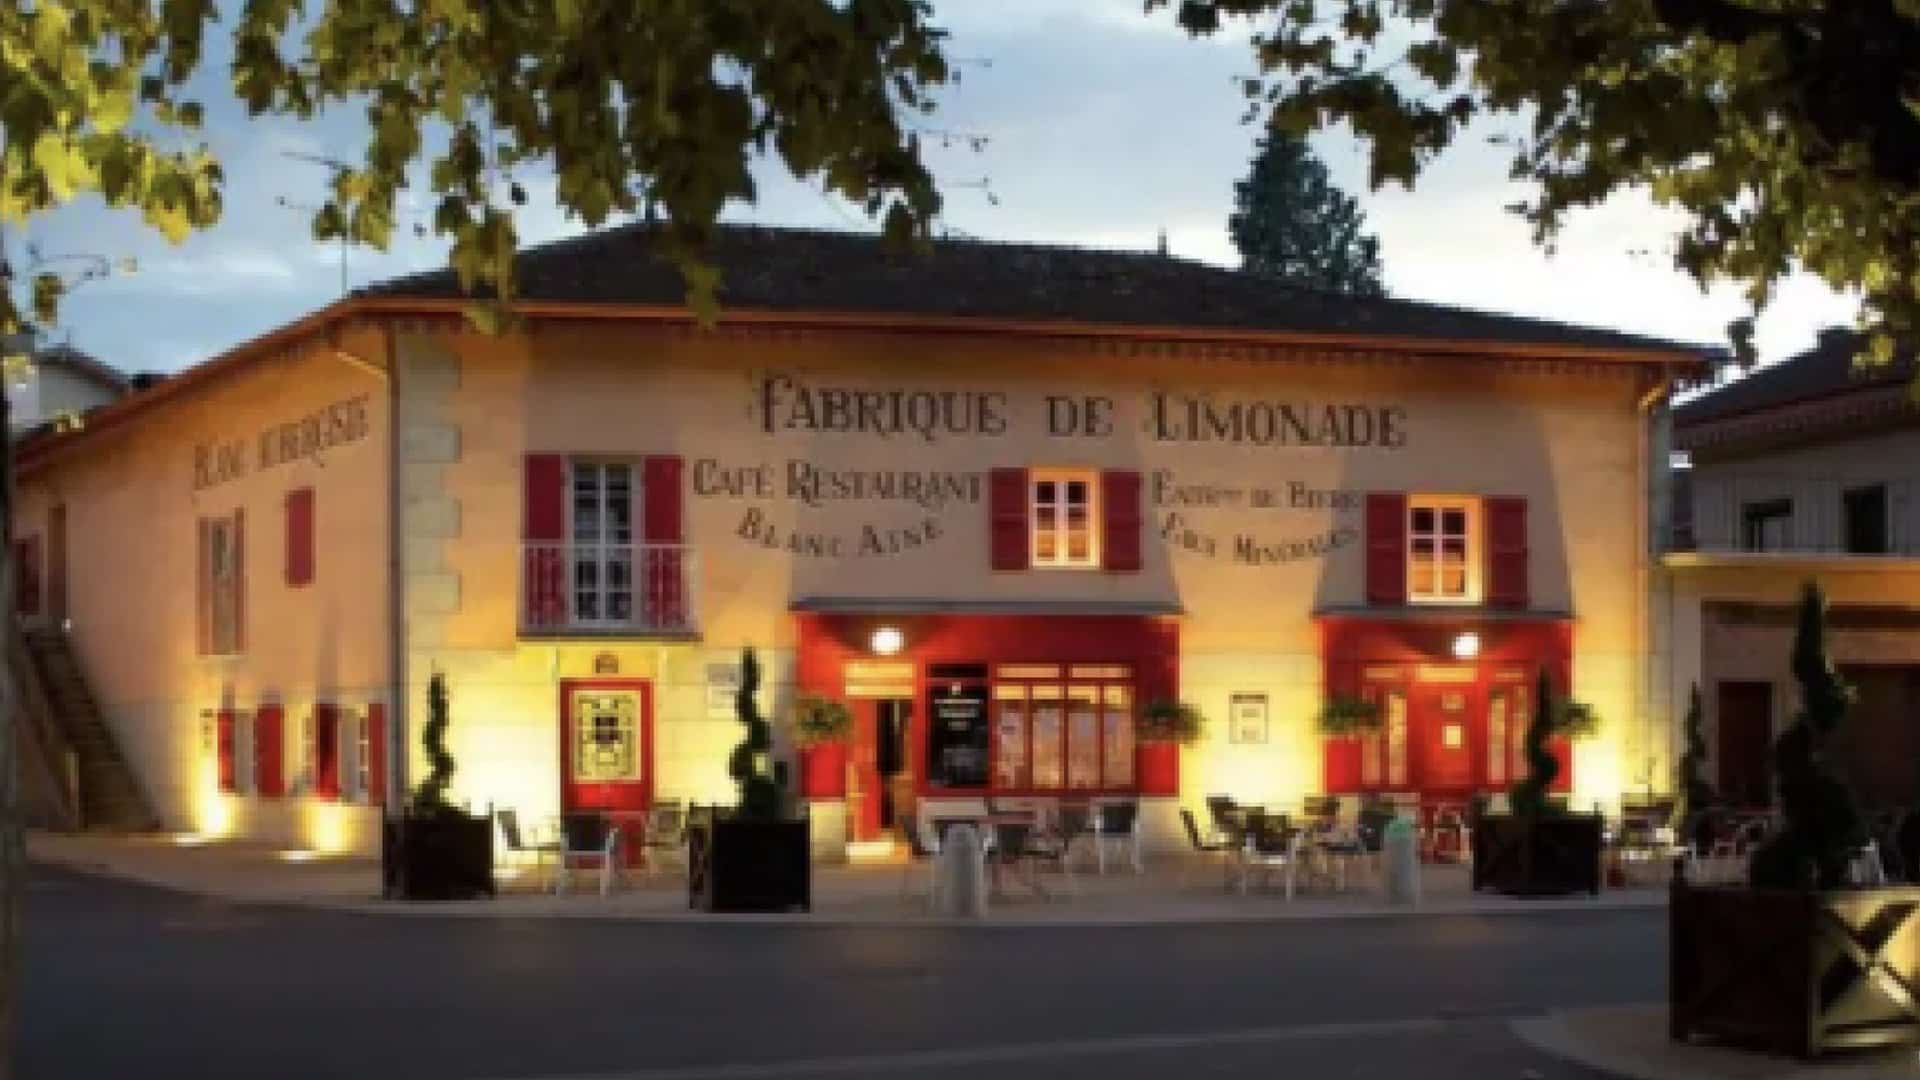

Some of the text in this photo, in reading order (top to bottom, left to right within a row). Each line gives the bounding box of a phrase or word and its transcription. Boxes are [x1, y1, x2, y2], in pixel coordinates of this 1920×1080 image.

[754, 374, 1407, 447] FABRIQUE DE LIMONADE
[786, 458, 982, 507] RESTAURANT
